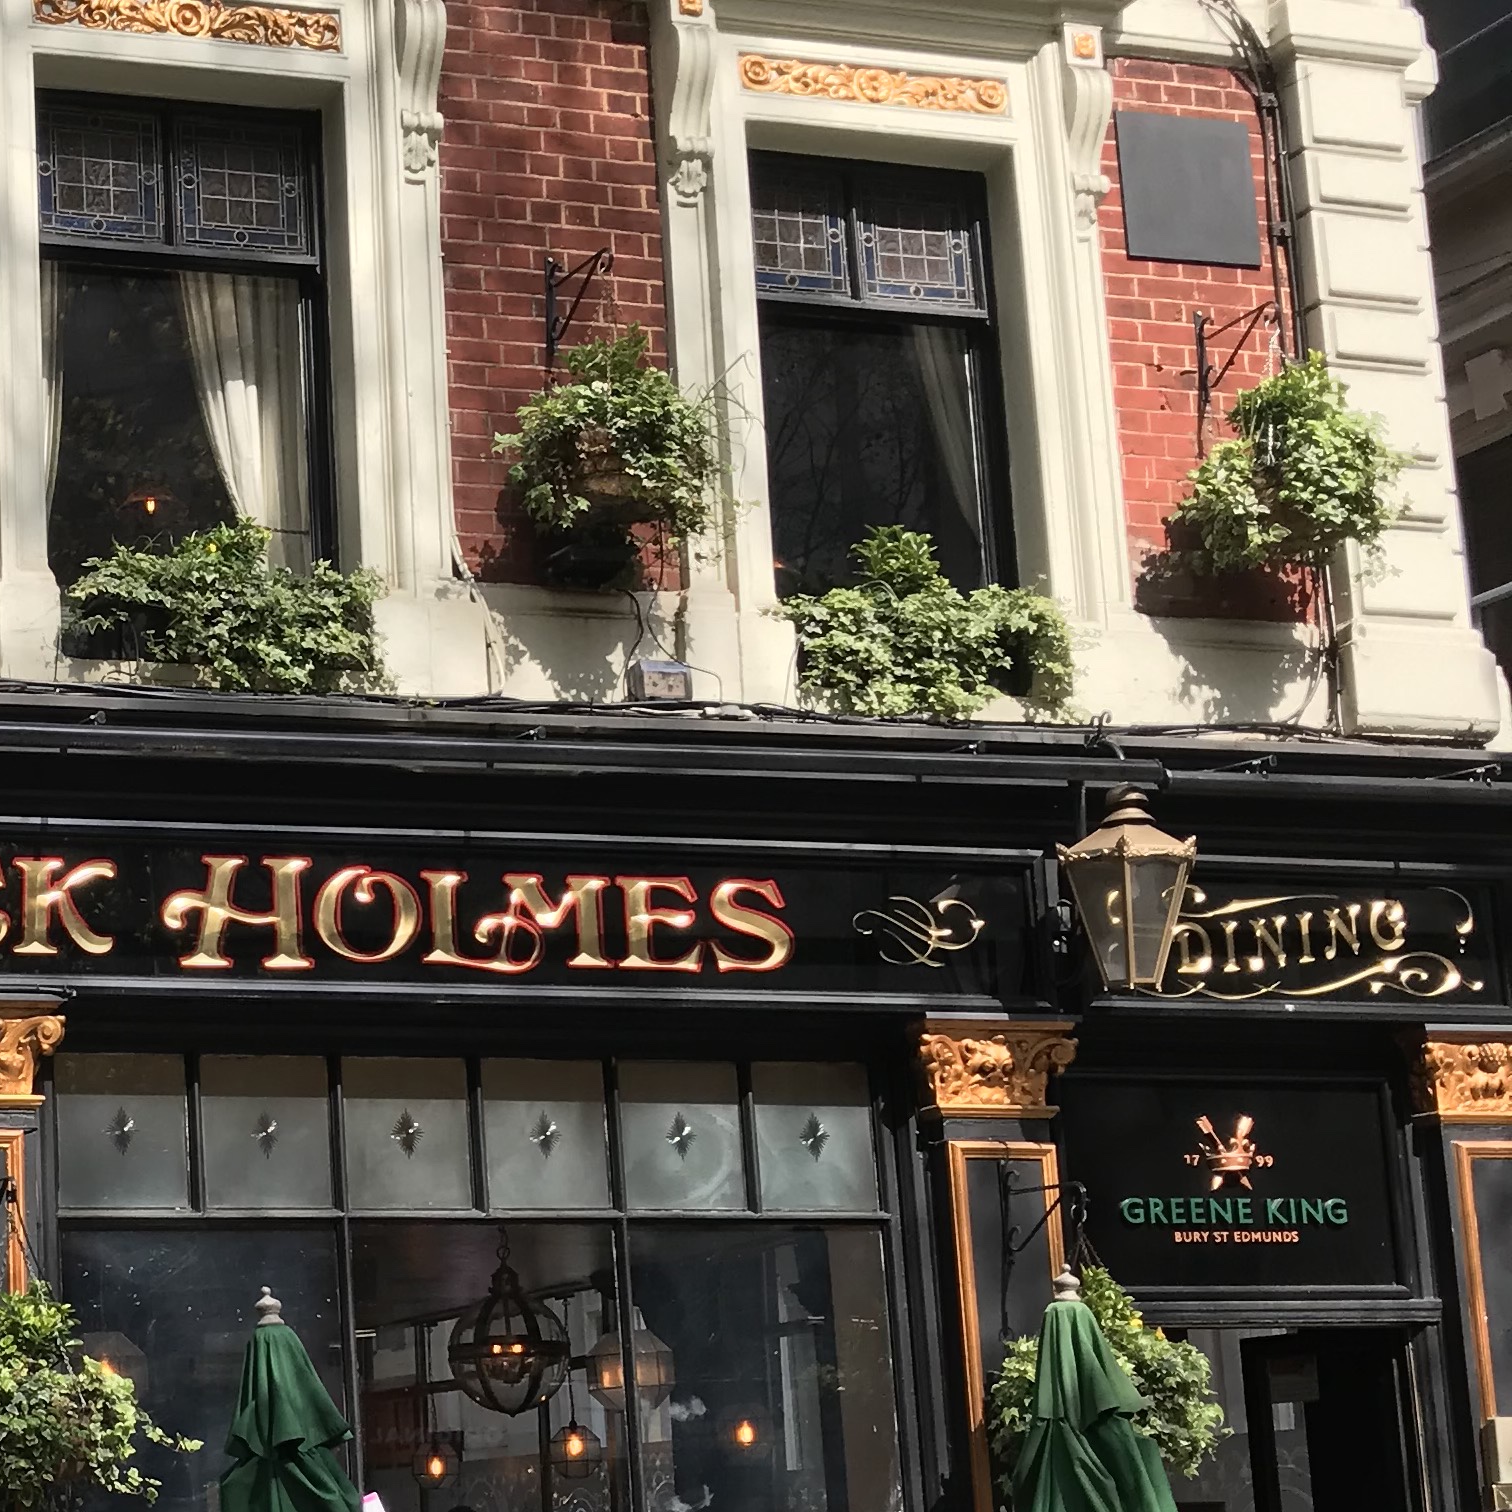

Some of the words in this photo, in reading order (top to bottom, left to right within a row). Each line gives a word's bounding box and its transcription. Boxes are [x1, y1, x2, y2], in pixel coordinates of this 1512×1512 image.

[161, 854, 795, 974] HOLMES
[1171, 898, 1407, 974] DINING
[1183, 1154, 1200, 1167] 17
[1255, 1155, 1274, 1168] 99
[1119, 1196, 1254, 1225] GREENE
[1266, 1196, 1349, 1225] KING
[1174, 1230, 1210, 1243] BURY
[1213, 1230, 1230, 1243] ST
[1233, 1230, 1300, 1243] EDMUNDS
